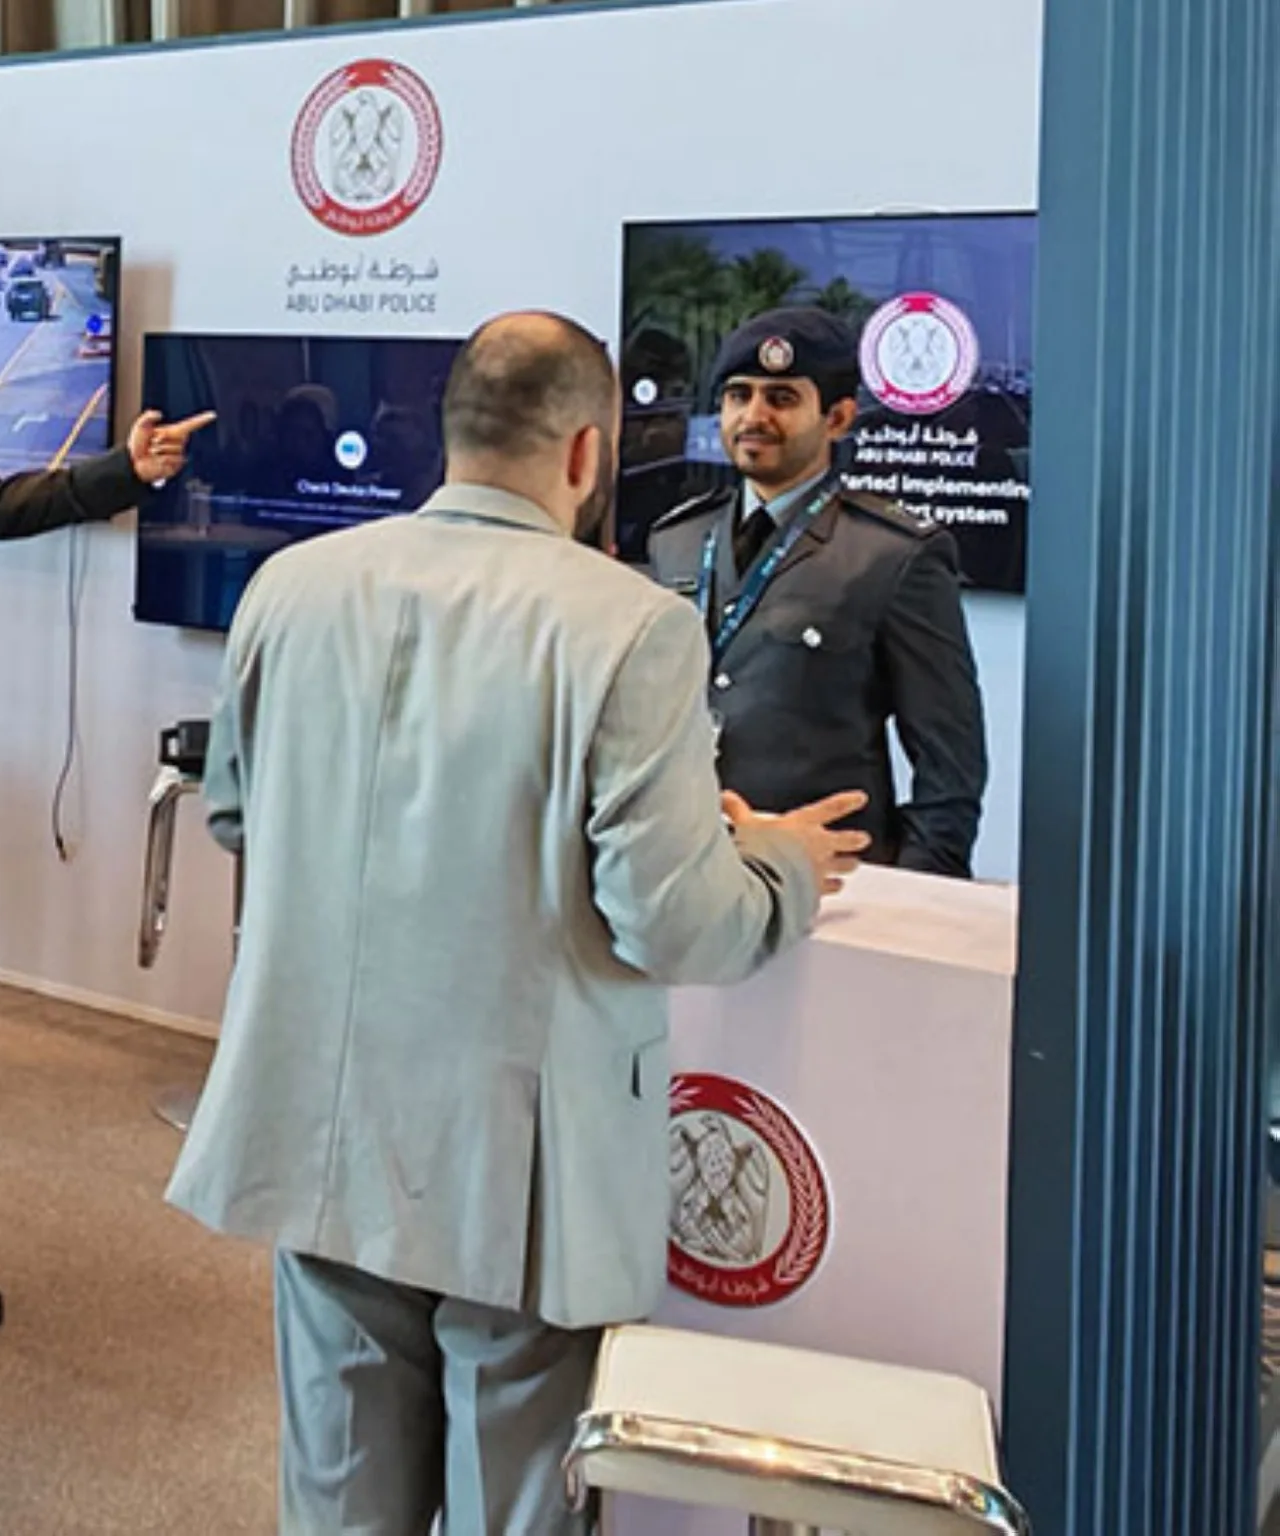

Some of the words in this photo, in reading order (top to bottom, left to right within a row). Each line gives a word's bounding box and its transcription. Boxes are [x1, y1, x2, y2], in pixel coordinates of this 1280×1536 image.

[367, 256, 439, 287] شرطة
[285, 293, 319, 313] ABU
[323, 293, 374, 313] DHABI
[379, 293, 437, 313] POLICE
[922, 425, 978, 449] شرطة
[855, 447, 883, 463] ABU
[886, 449, 927, 464] DHABI
[930, 450, 976, 467] POLICE
[901, 474, 1031, 499] implementin
[934, 504, 1009, 525] system
